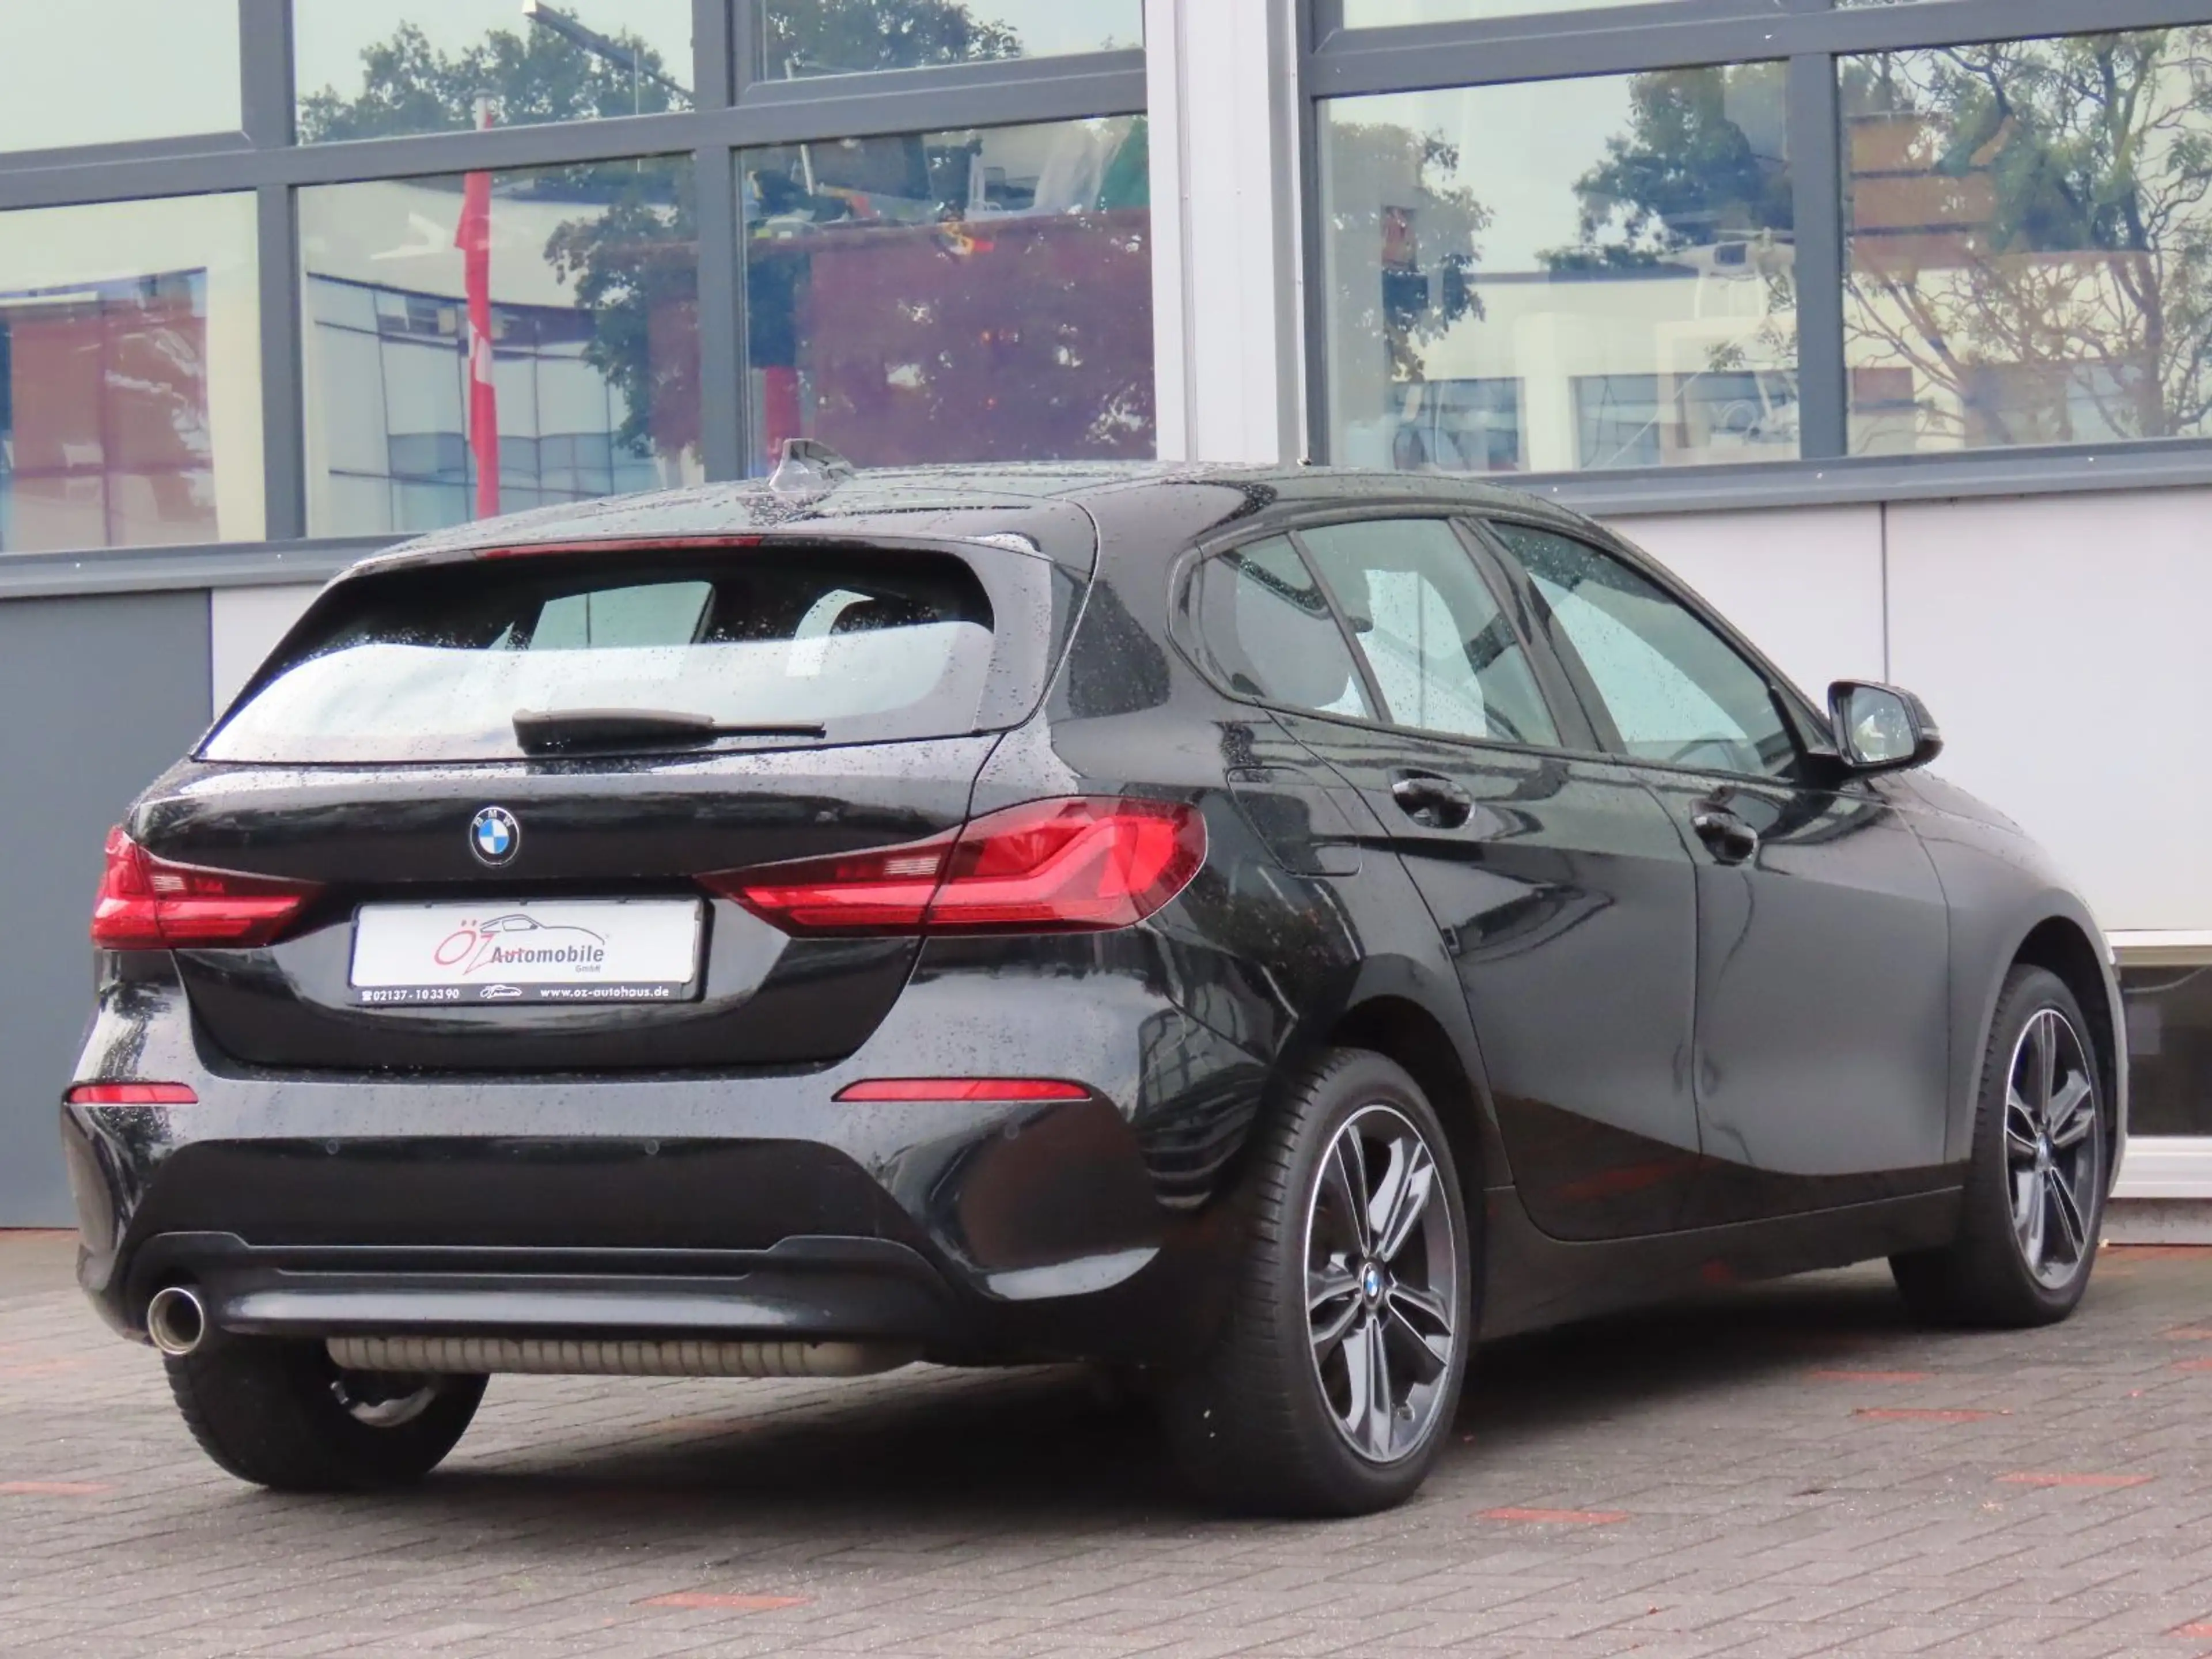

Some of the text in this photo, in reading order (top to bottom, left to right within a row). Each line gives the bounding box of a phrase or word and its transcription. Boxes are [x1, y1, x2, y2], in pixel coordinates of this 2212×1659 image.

[474, 809, 514, 827] BMW
[491, 945, 604, 963] Automobile
[575, 964, 601, 973] GmbH
[540, 986, 669, 998] www.oz-autohaus.de
